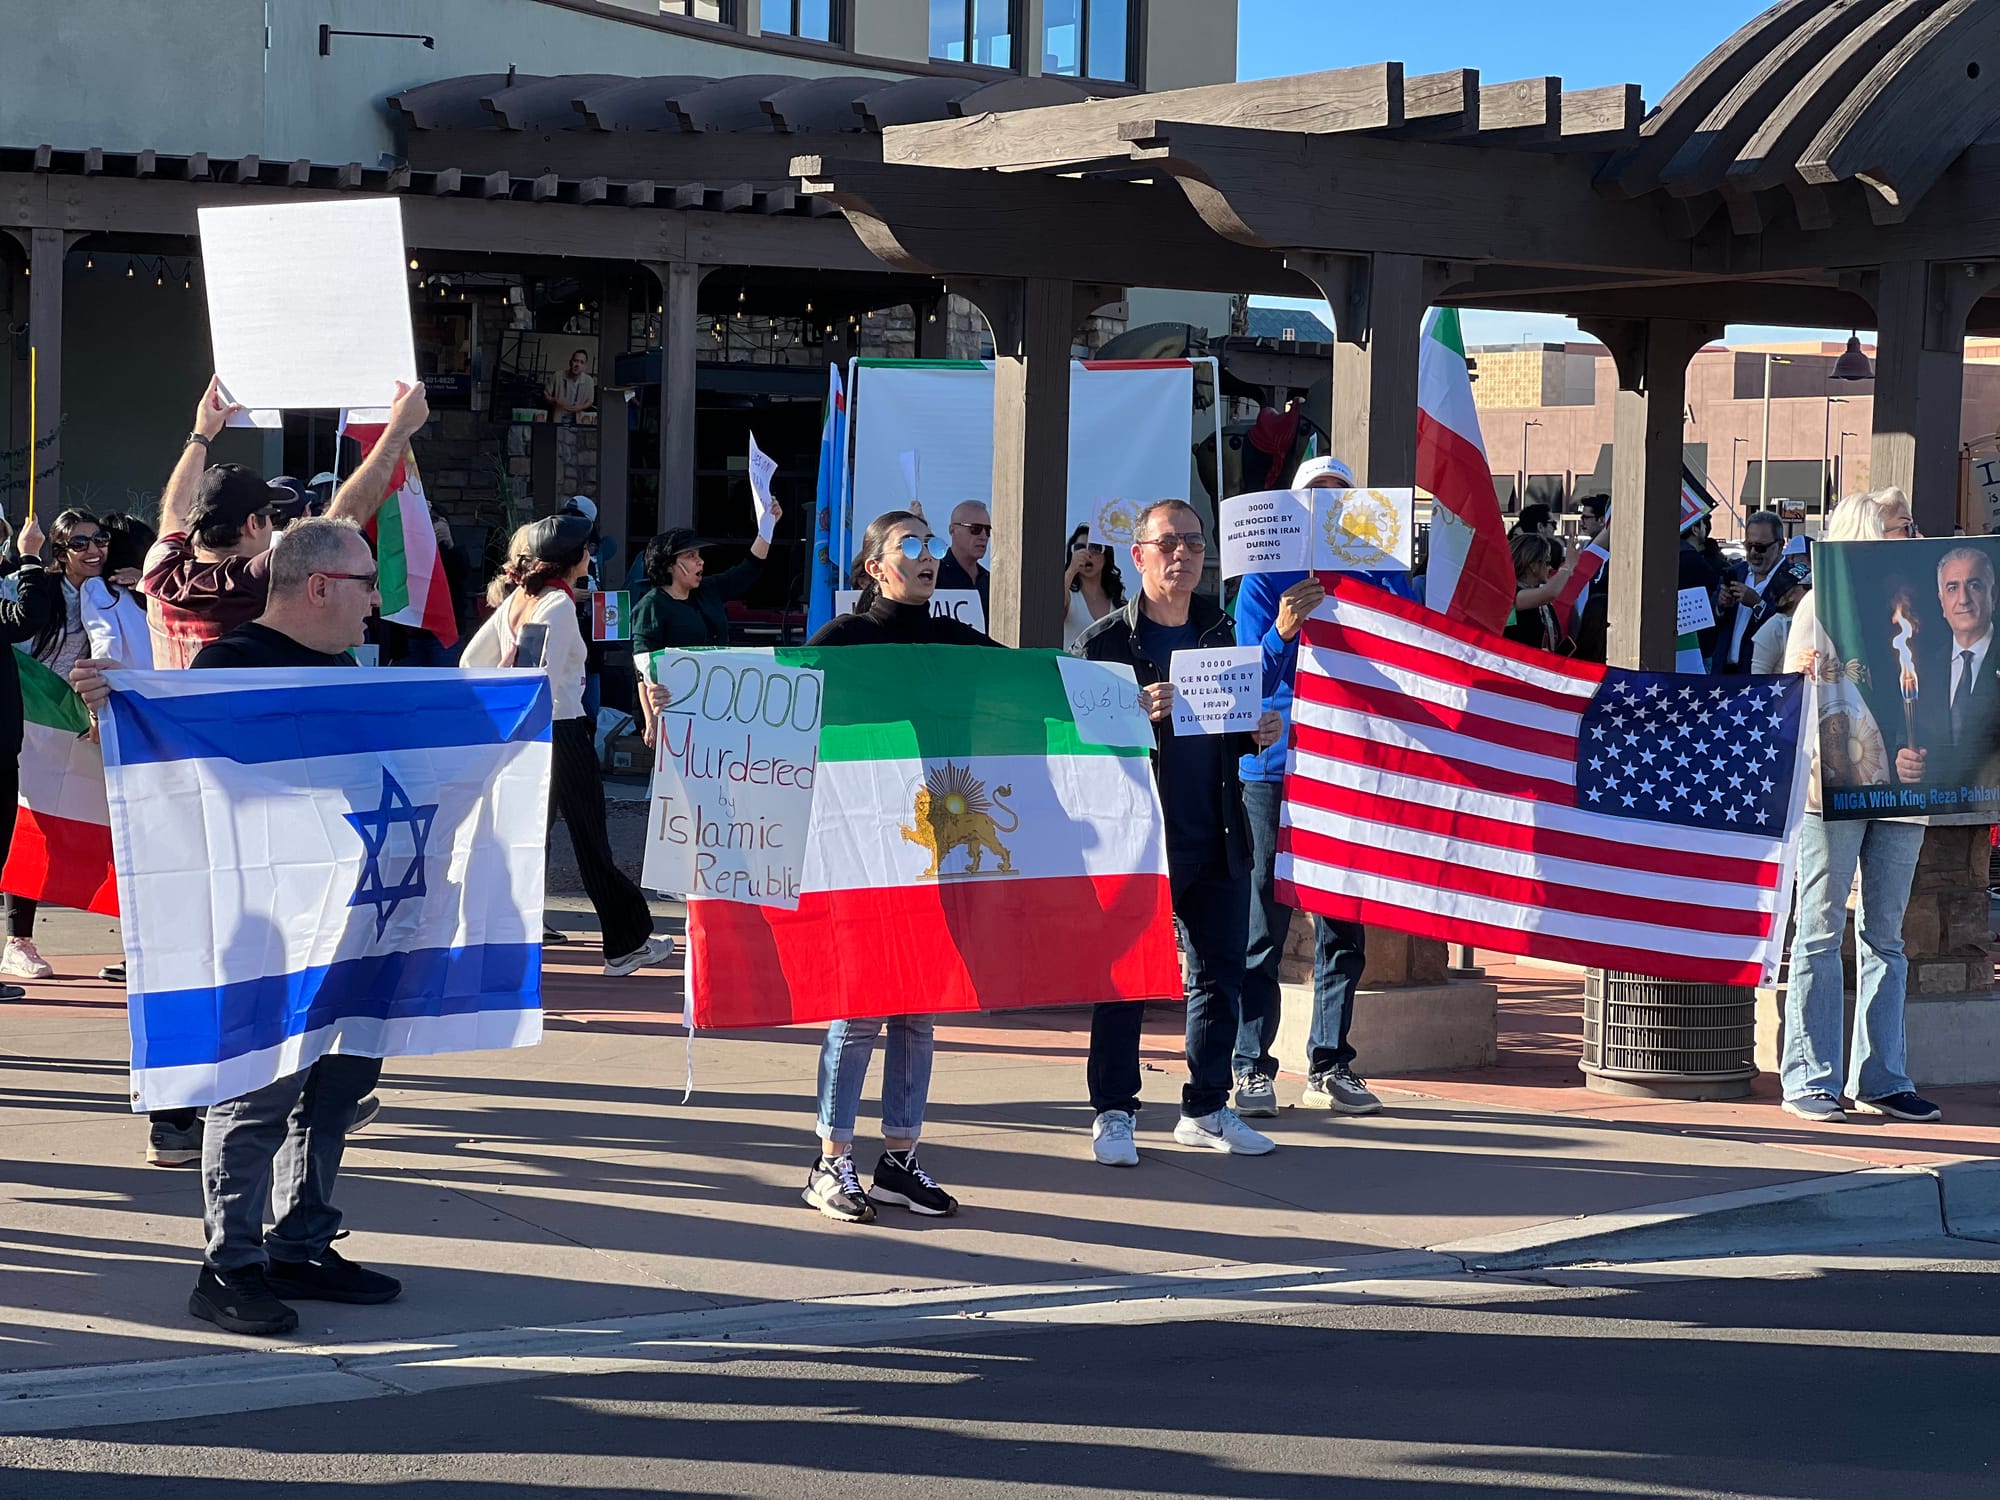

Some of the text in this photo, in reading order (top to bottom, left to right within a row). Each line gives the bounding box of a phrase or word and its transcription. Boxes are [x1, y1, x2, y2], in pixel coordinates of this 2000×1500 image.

[1248, 503, 1274, 512] 30000
[1234, 514, 1293, 527] GENOCIDE BY
[1228, 529, 1266, 541] MULLAHS
[1280, 526, 1301, 534] IRAN
[1246, 541, 1281, 549] DURING
[1200, 659, 1232, 668] 30000
[1180, 672, 1254, 683] GENOCIDE BY
[661, 656, 821, 732] 20,000
[1182, 685, 1250, 696] MULLAHS IN
[1203, 700, 1229, 708] IRAN
[659, 716, 818, 790] Murdered
[718, 785, 736, 818] by
[1833, 784, 2000, 811] MIGA With King Reza Pahlavi
[658, 796, 784, 850] Islamic
